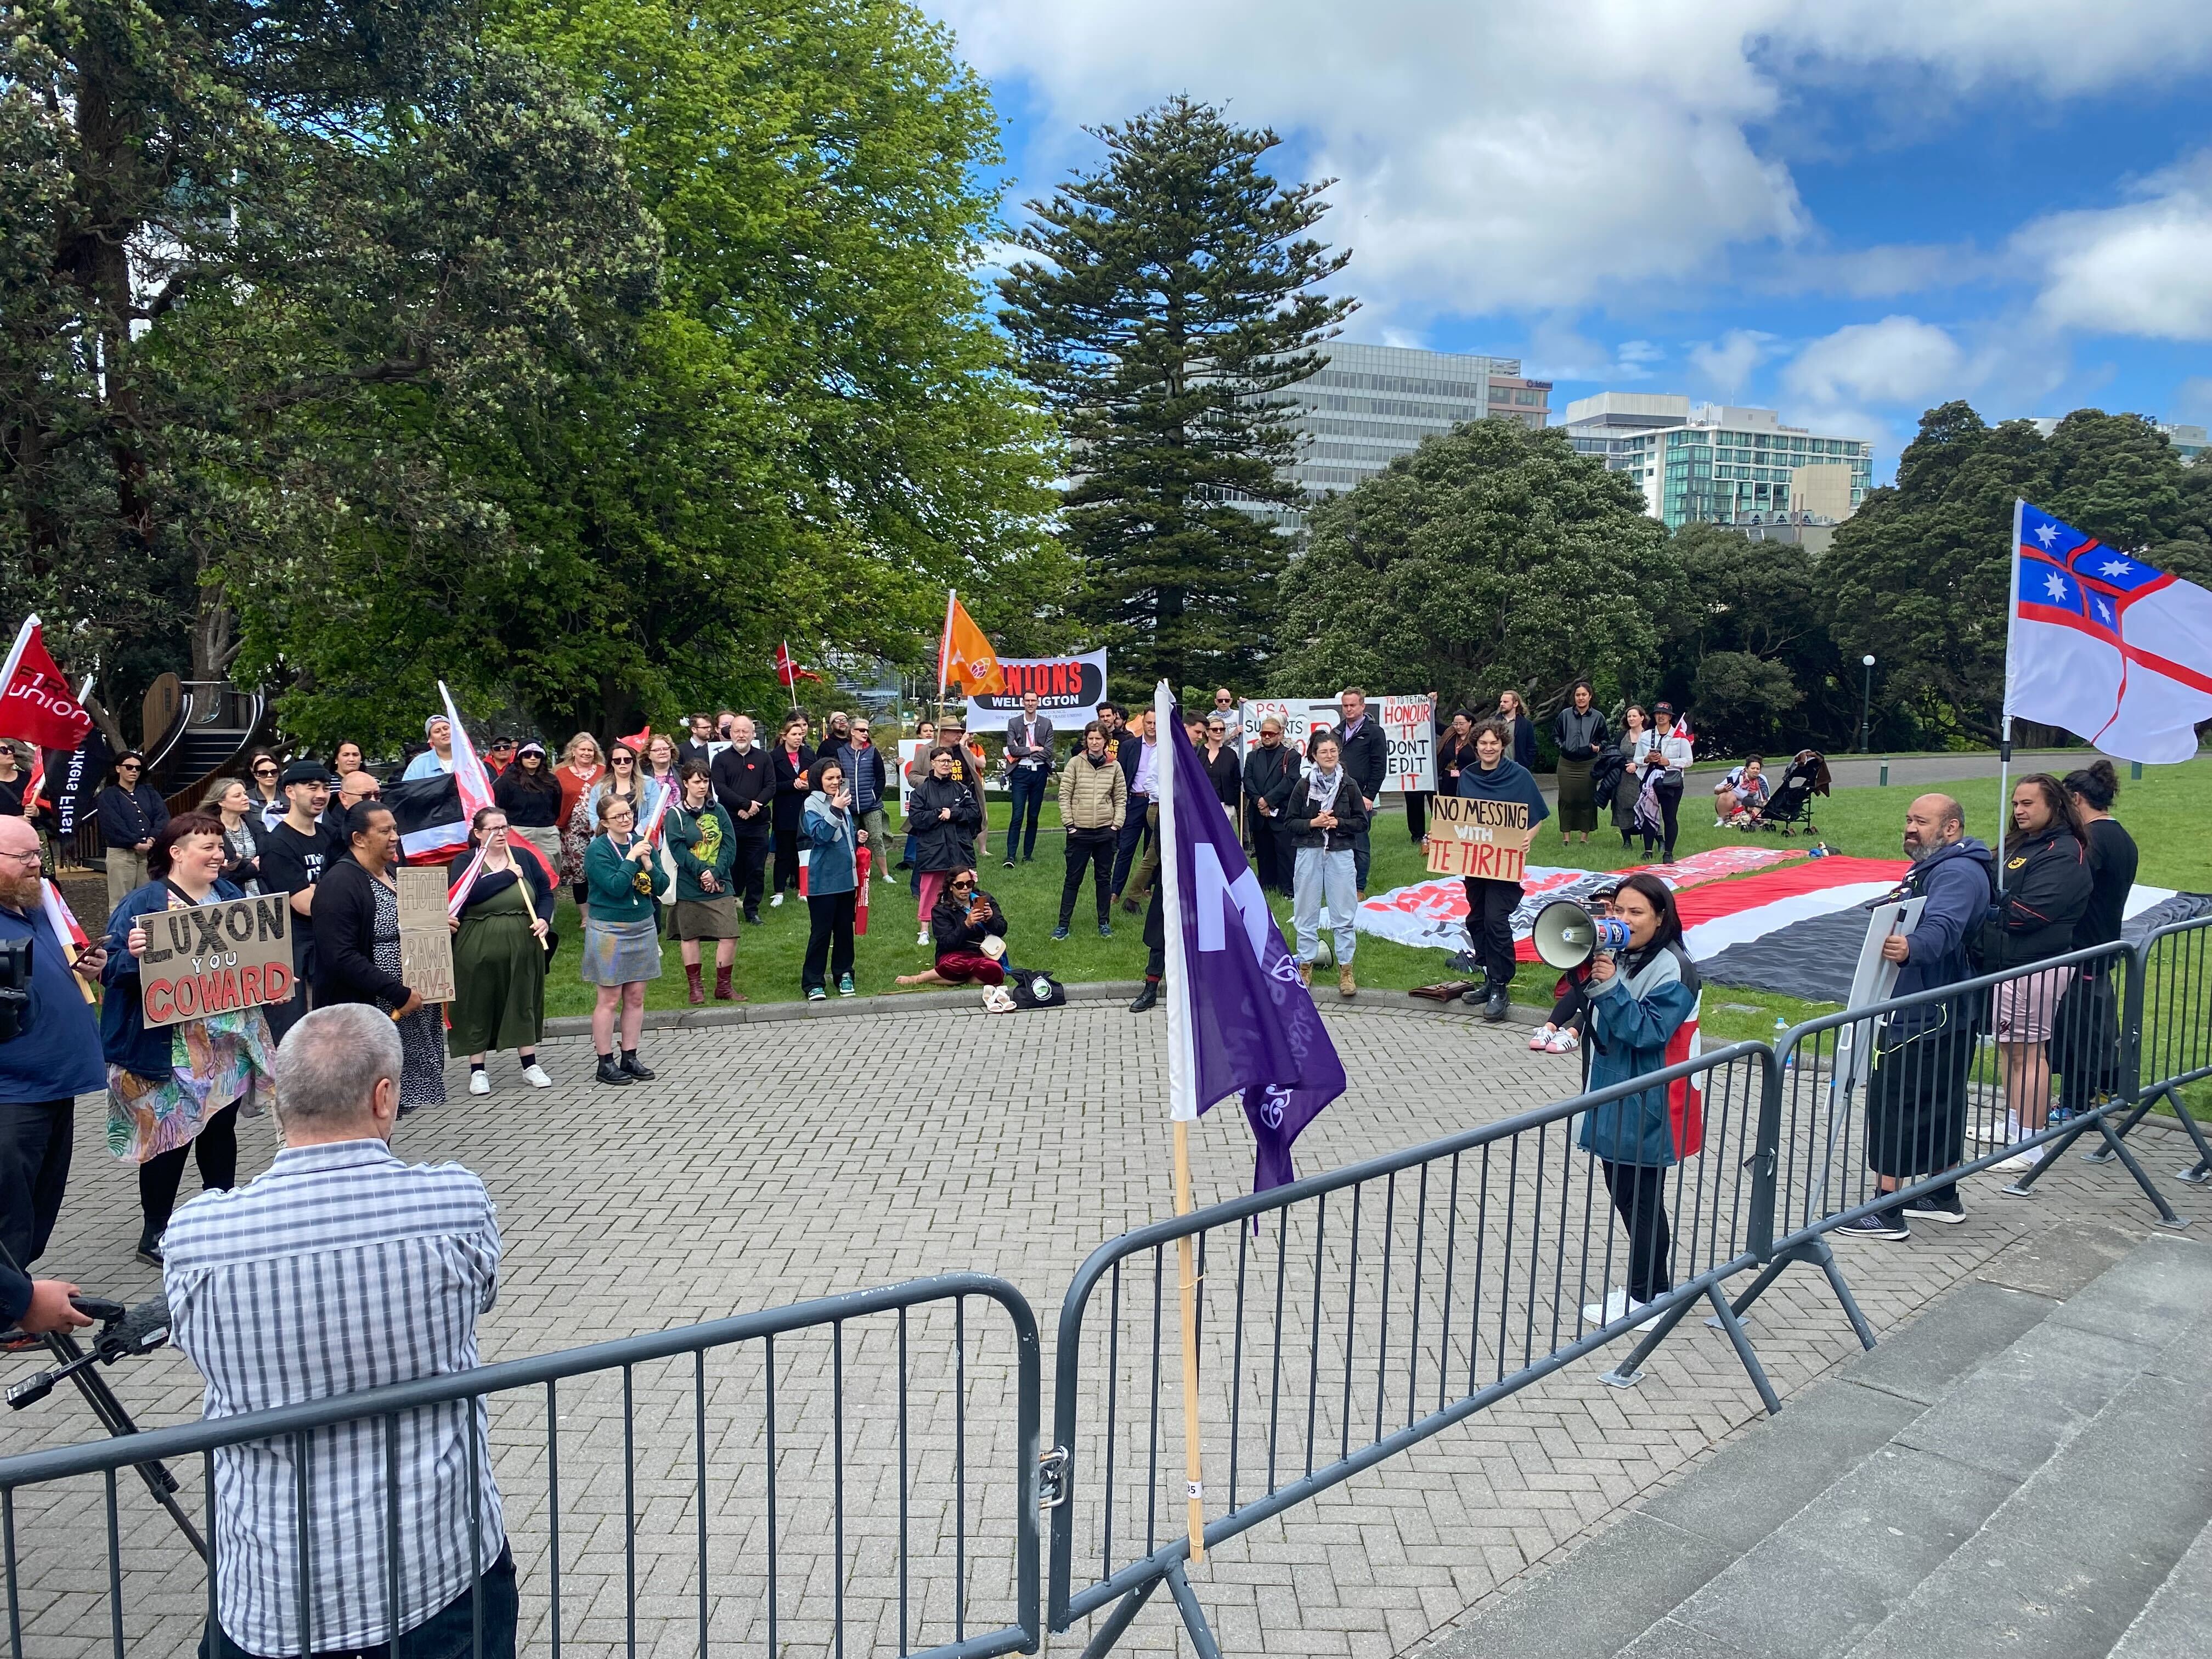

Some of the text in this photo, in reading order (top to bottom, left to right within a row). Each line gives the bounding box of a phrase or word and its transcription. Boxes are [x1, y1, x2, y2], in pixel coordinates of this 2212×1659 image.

[991, 695, 1079, 707] WELLGTON
[1385, 705, 1431, 724] HONOUR
[1245, 720, 1302, 734] SURTS
[1402, 724, 1417, 740] IT
[1389, 757, 1426, 774] EDIT
[1401, 774, 1419, 791] IT
[1434, 797, 1527, 830] NO MESSING
[1454, 825, 1493, 842] WITH
[1431, 839, 1523, 881] TE TIRITI
[142, 897, 284, 964] LUXON
[191, 951, 238, 974] YOU
[408, 936, 450, 970] RAWA
[145, 961, 292, 1023] COWARD
